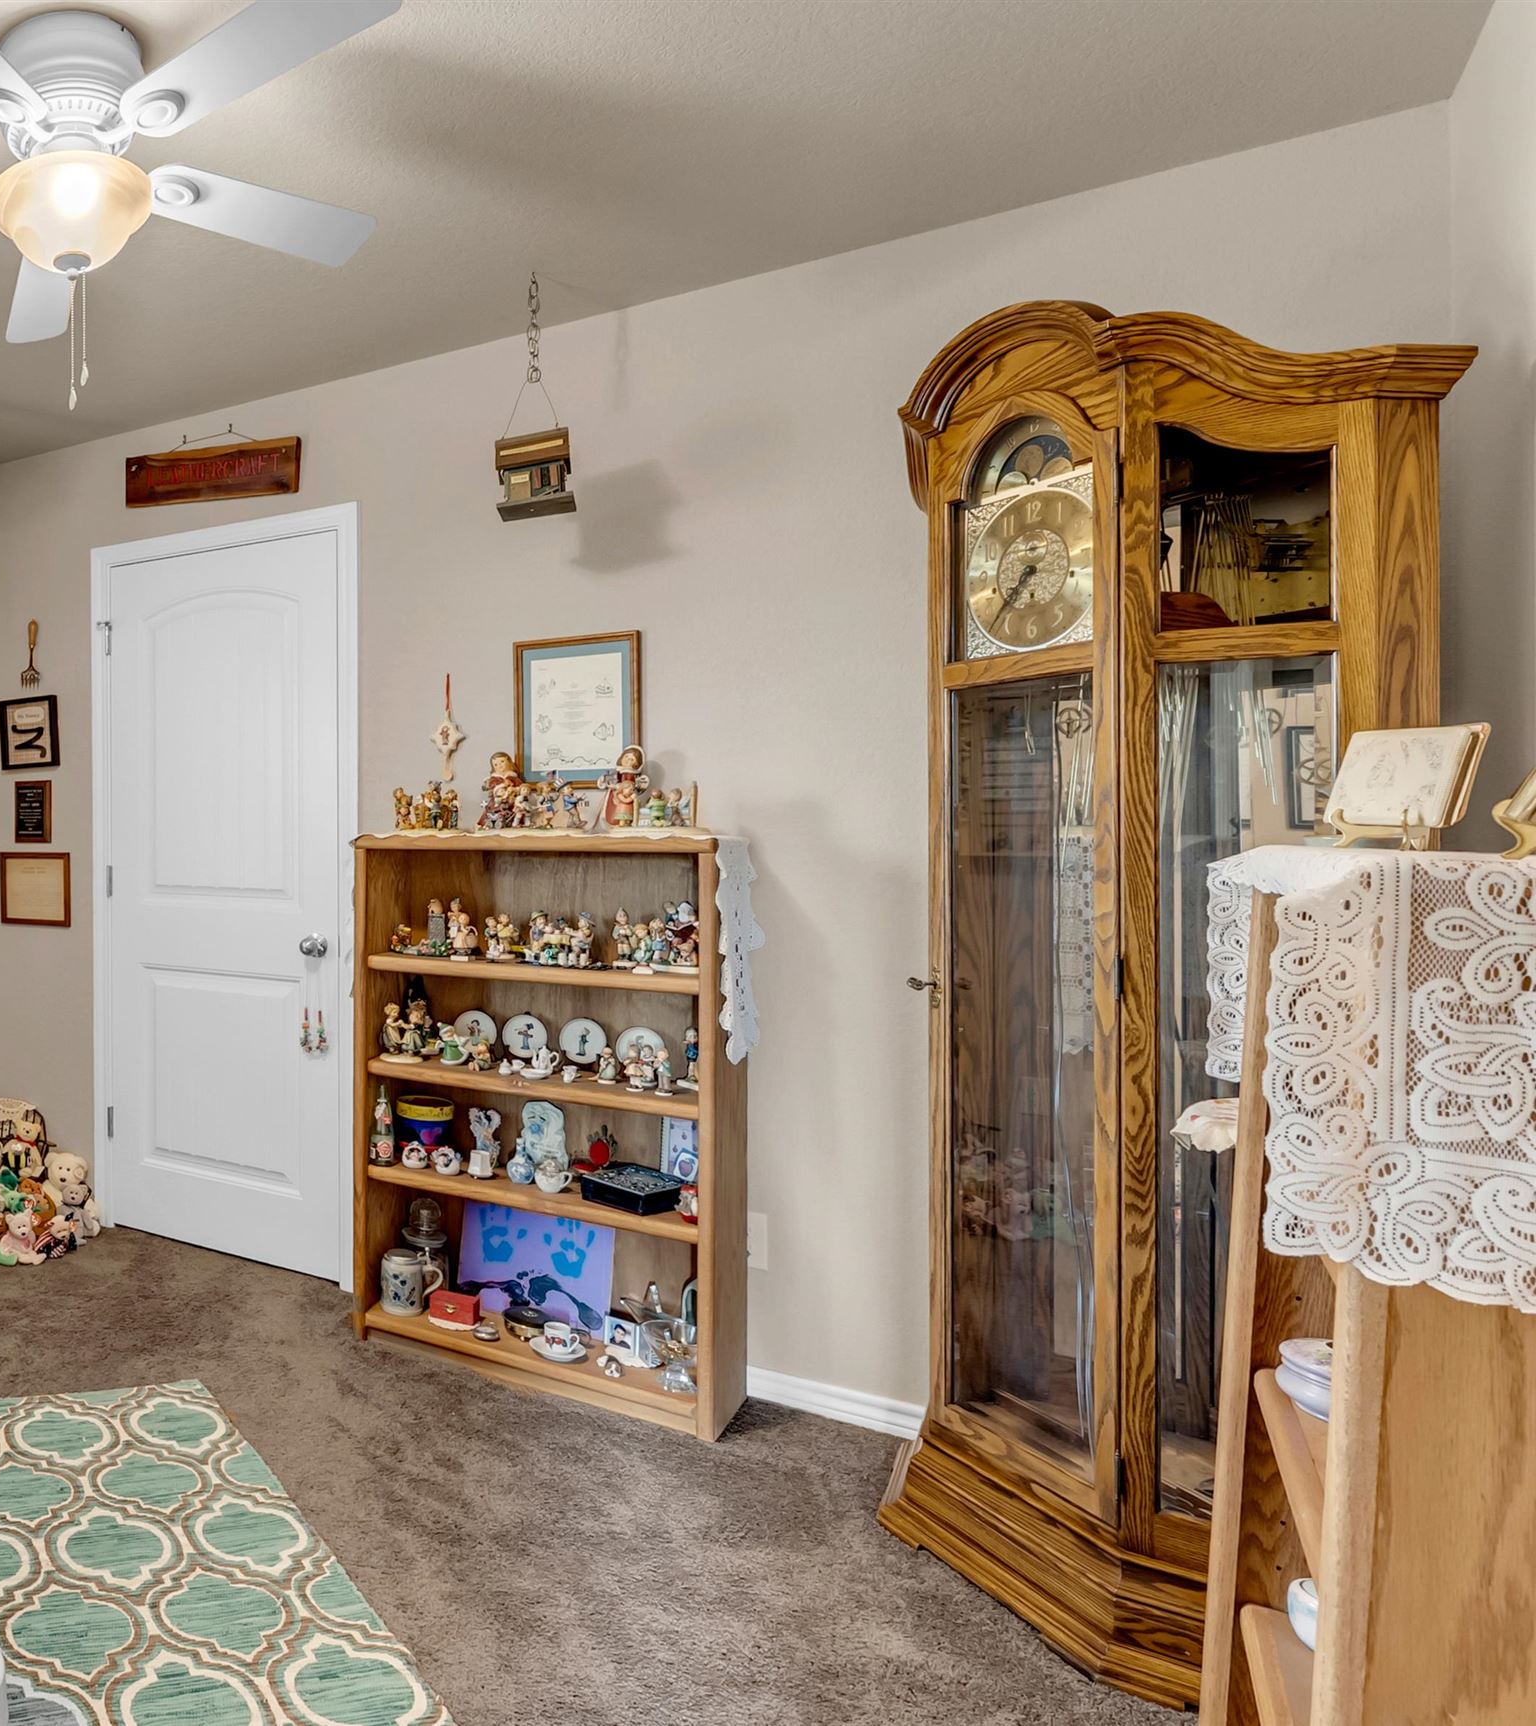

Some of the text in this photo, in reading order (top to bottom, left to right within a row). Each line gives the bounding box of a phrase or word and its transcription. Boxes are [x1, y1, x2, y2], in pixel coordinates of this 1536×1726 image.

[145, 453, 280, 488] LEATHERCRAFT
[1025, 500, 1042, 524] 12
[1003, 514, 1015, 537] 11
[984, 542, 998, 563] 10
[1025, 615, 1038, 639] 6
